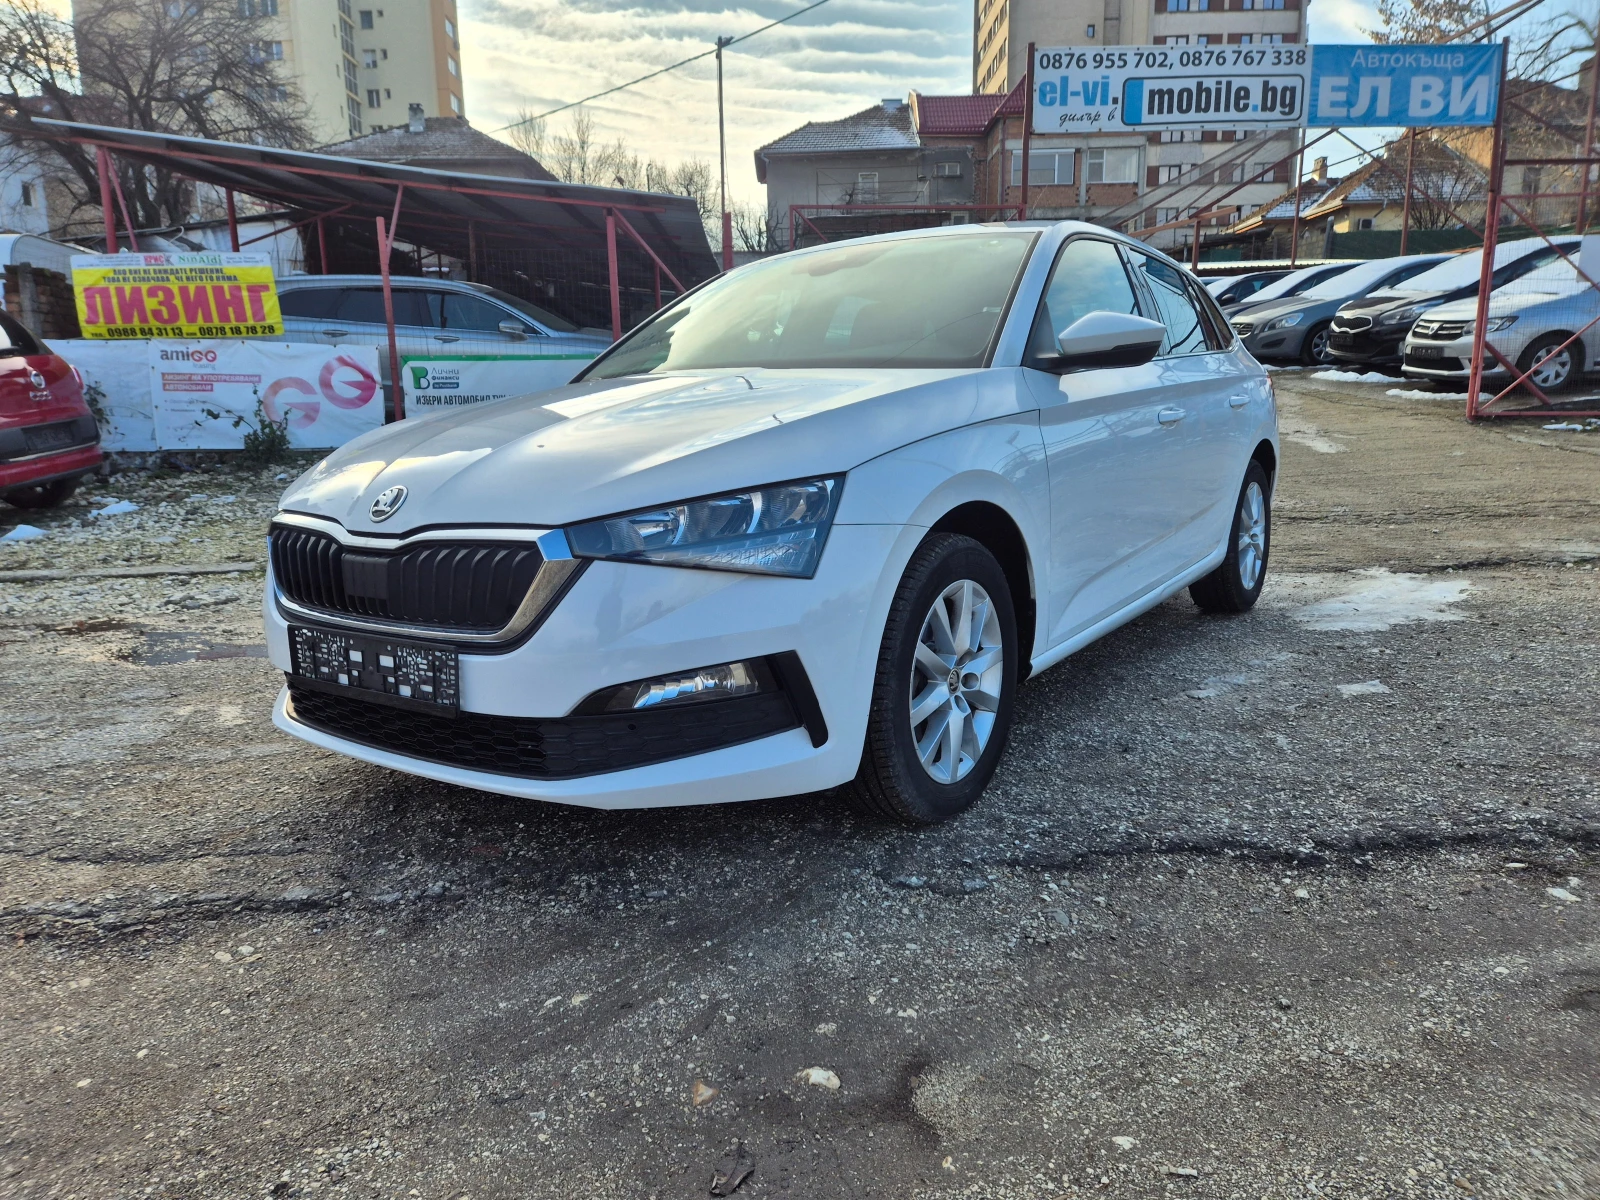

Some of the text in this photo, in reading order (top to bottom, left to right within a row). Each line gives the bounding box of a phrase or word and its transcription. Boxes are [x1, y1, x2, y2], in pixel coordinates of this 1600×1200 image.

[1040, 50, 1306, 70] 0876 955 702, 0876 767 338
[1351, 49, 1464, 70] Автокъща
[1147, 80, 1296, 116] mobile.bg
[1317, 75, 1489, 118] ЕЛ ВИ
[1059, 107, 1117, 127] дилър в
[153, 267, 187, 275] ВИЖДАТЕ
[83, 284, 271, 325] ЛИЗИНГ
[107, 327, 137, 337] 0988
[139, 327, 154, 337] 84
[155, 327, 169, 337] 31
[170, 327, 183, 337] 13
[199, 326, 227, 336] 0878
[228, 326, 242, 335] 18
[243, 325, 258, 335] 78
[260, 325, 275, 334] 28
[202, 374, 260, 382] УПОТРЕБЯВАНИ
[431, 367, 460, 375] Лични
